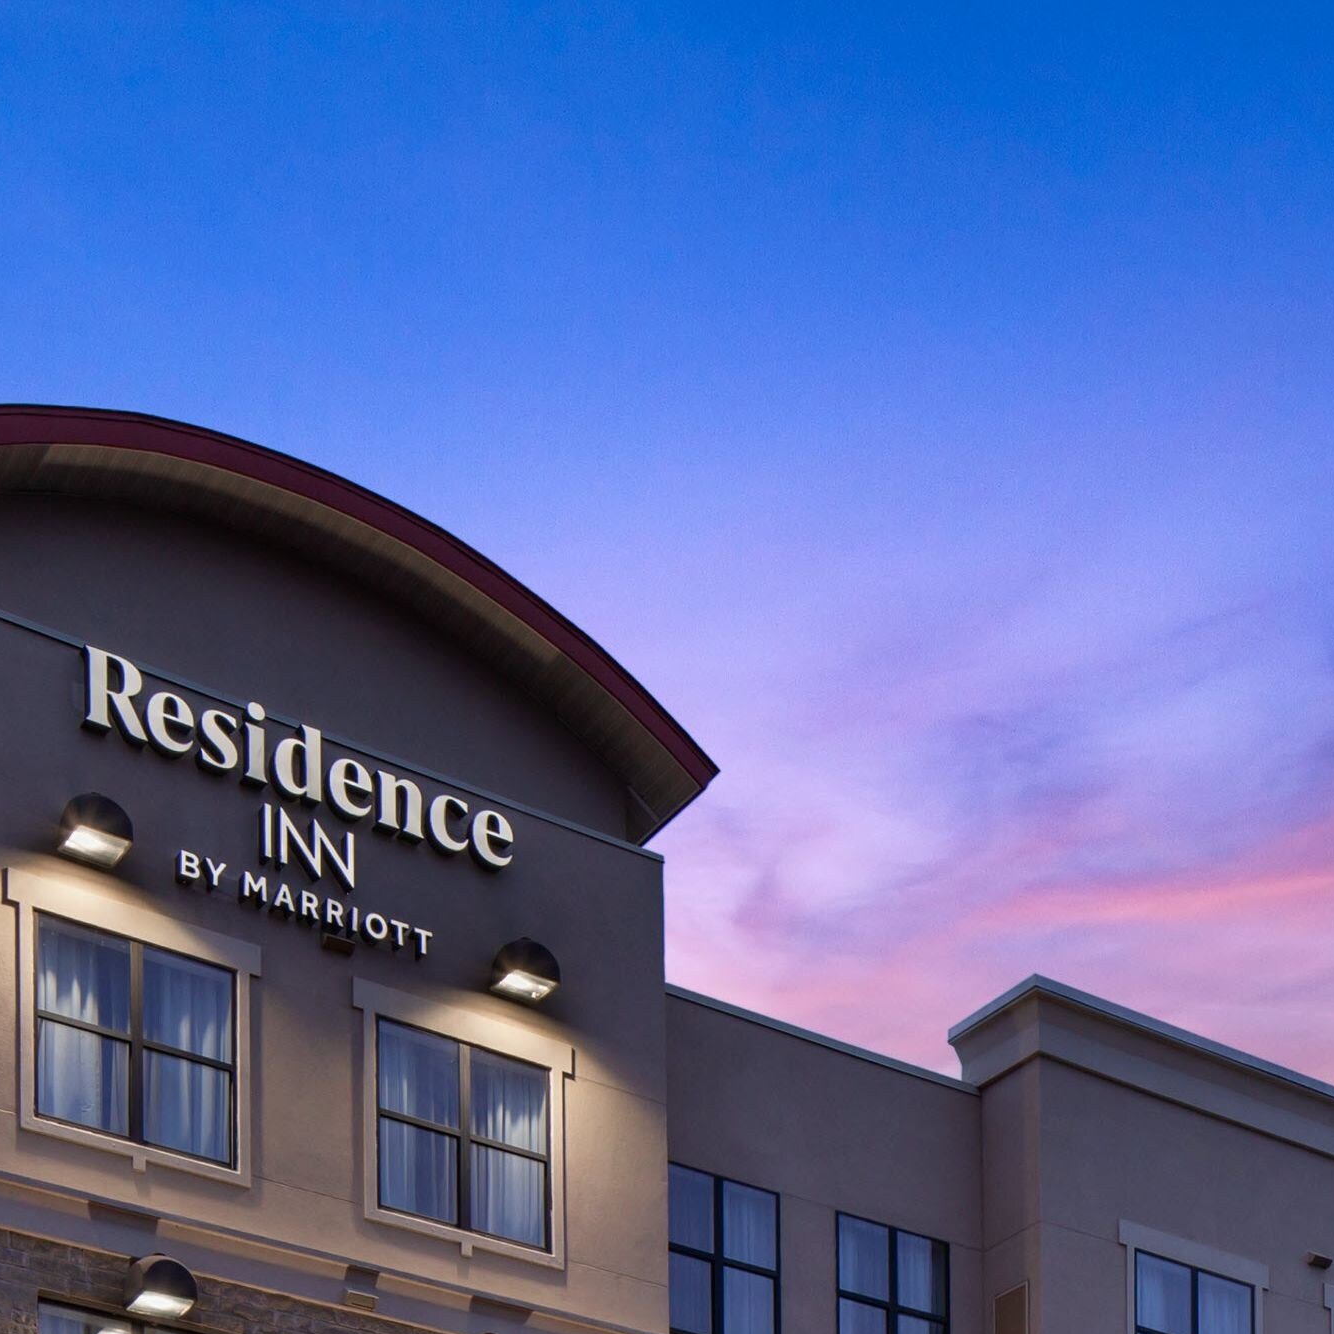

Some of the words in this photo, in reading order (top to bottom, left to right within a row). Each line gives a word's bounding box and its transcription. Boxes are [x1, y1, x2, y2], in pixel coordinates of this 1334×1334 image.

[82, 644, 514, 869] Residence
[260, 802, 355, 892] INN
[176, 849, 227, 887] BY
[242, 870, 433, 958] MARRIOTT
